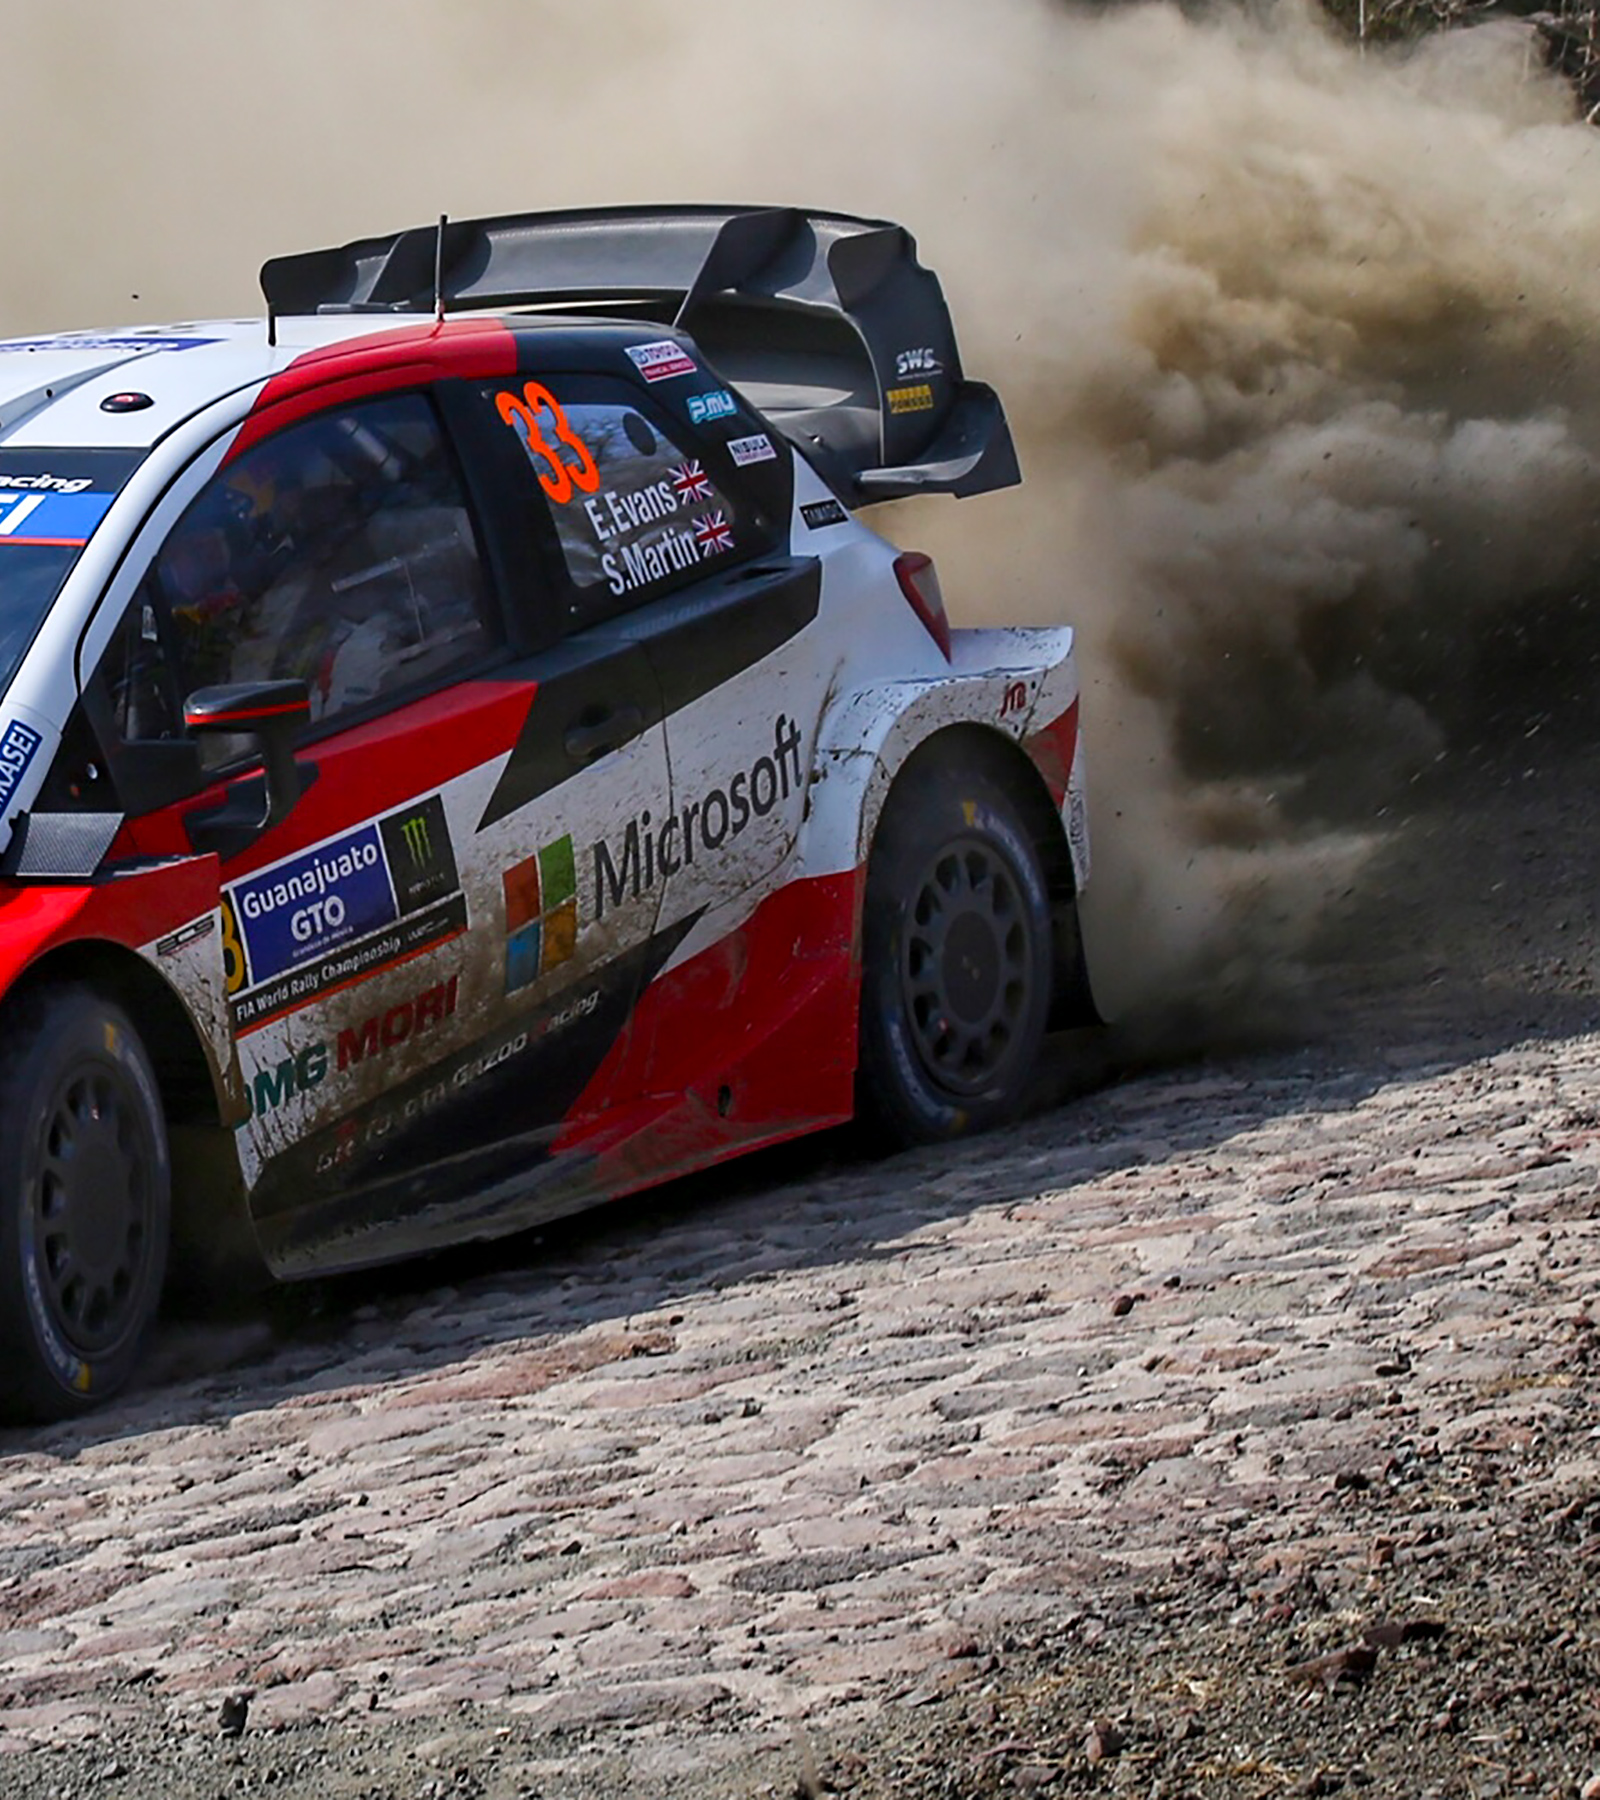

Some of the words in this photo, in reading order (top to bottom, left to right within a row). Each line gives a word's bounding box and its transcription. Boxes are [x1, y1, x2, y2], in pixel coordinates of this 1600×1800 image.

[896, 348, 934, 374] SWS
[495, 381, 600, 504] 33
[584, 479, 678, 542] E.Evans
[601, 527, 701, 596] S.Martin
[593, 711, 803, 921] Microsoft
[242, 843, 378, 919] Guanajuato
[291, 895, 345, 942] GTO
[236, 1000, 255, 1022] FIA
[256, 984, 288, 1011] World
[290, 970, 320, 997] Rally
[320, 935, 402, 982] Championship
[337, 975, 460, 1072] MORI
